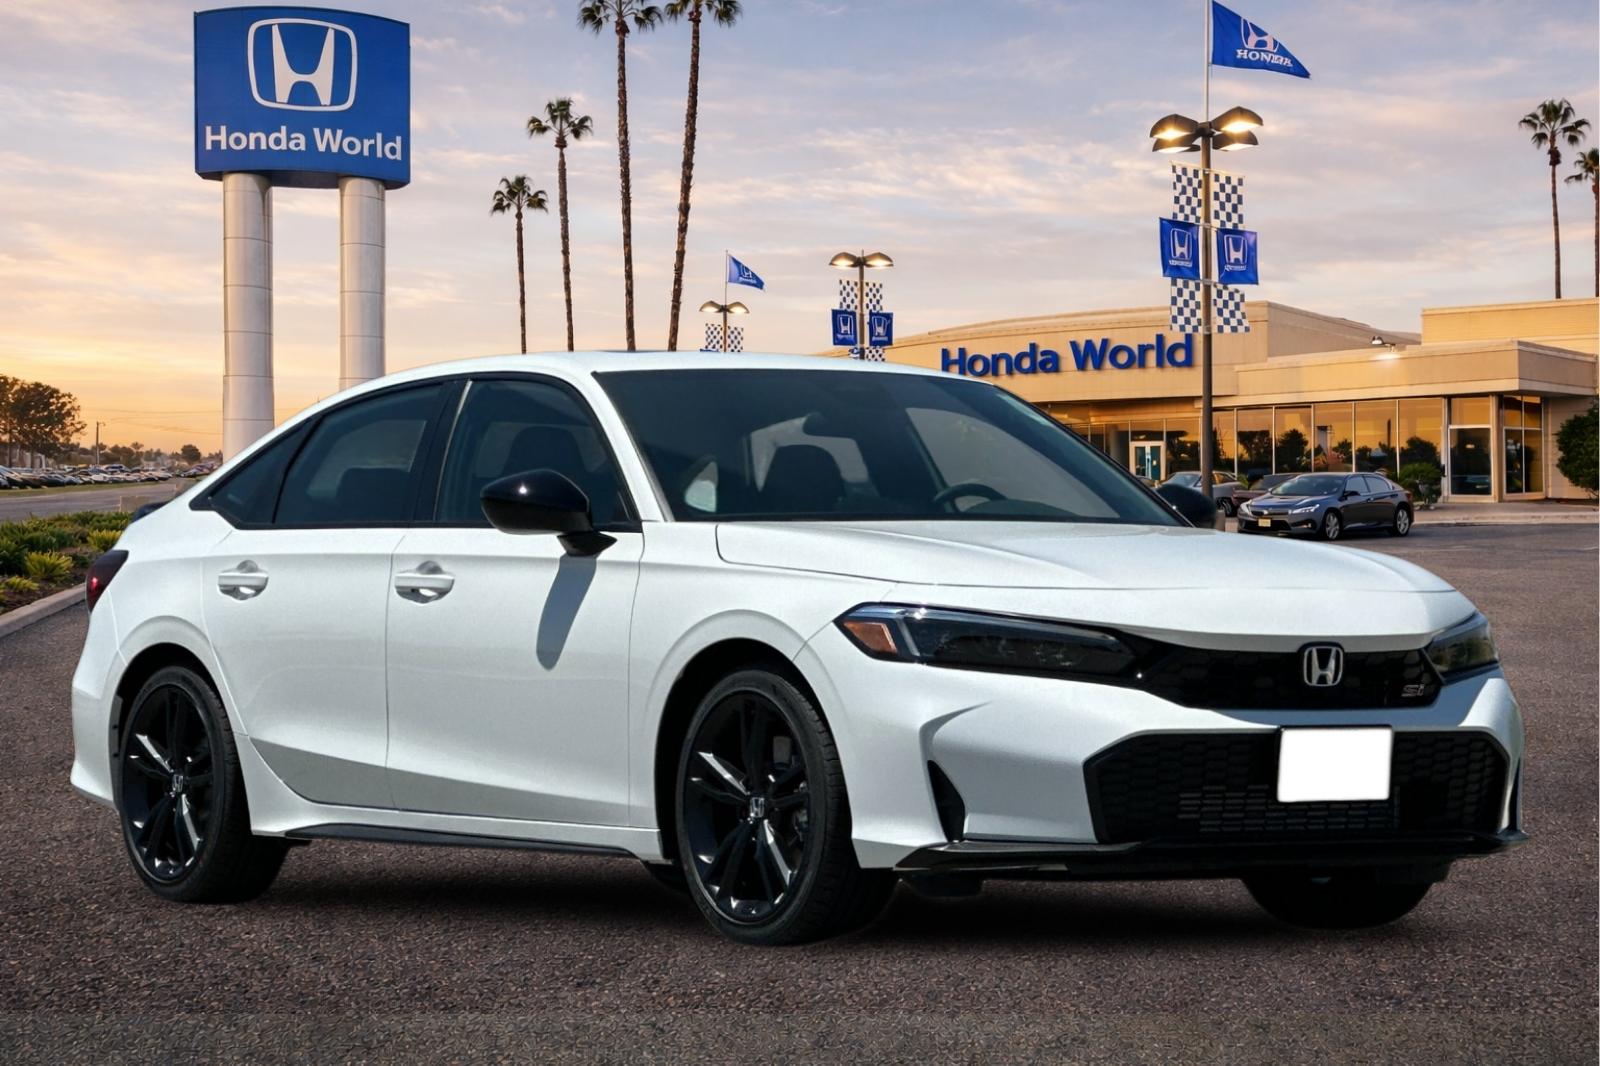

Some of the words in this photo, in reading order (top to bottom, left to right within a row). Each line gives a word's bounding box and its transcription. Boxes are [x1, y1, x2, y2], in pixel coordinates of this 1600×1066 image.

[205, 125, 306, 151] Honda
[313, 127, 402, 161] World
[941, 342, 1060, 377] Honda
[1069, 333, 1194, 371] World
[1401, 683, 1425, 698] Si
